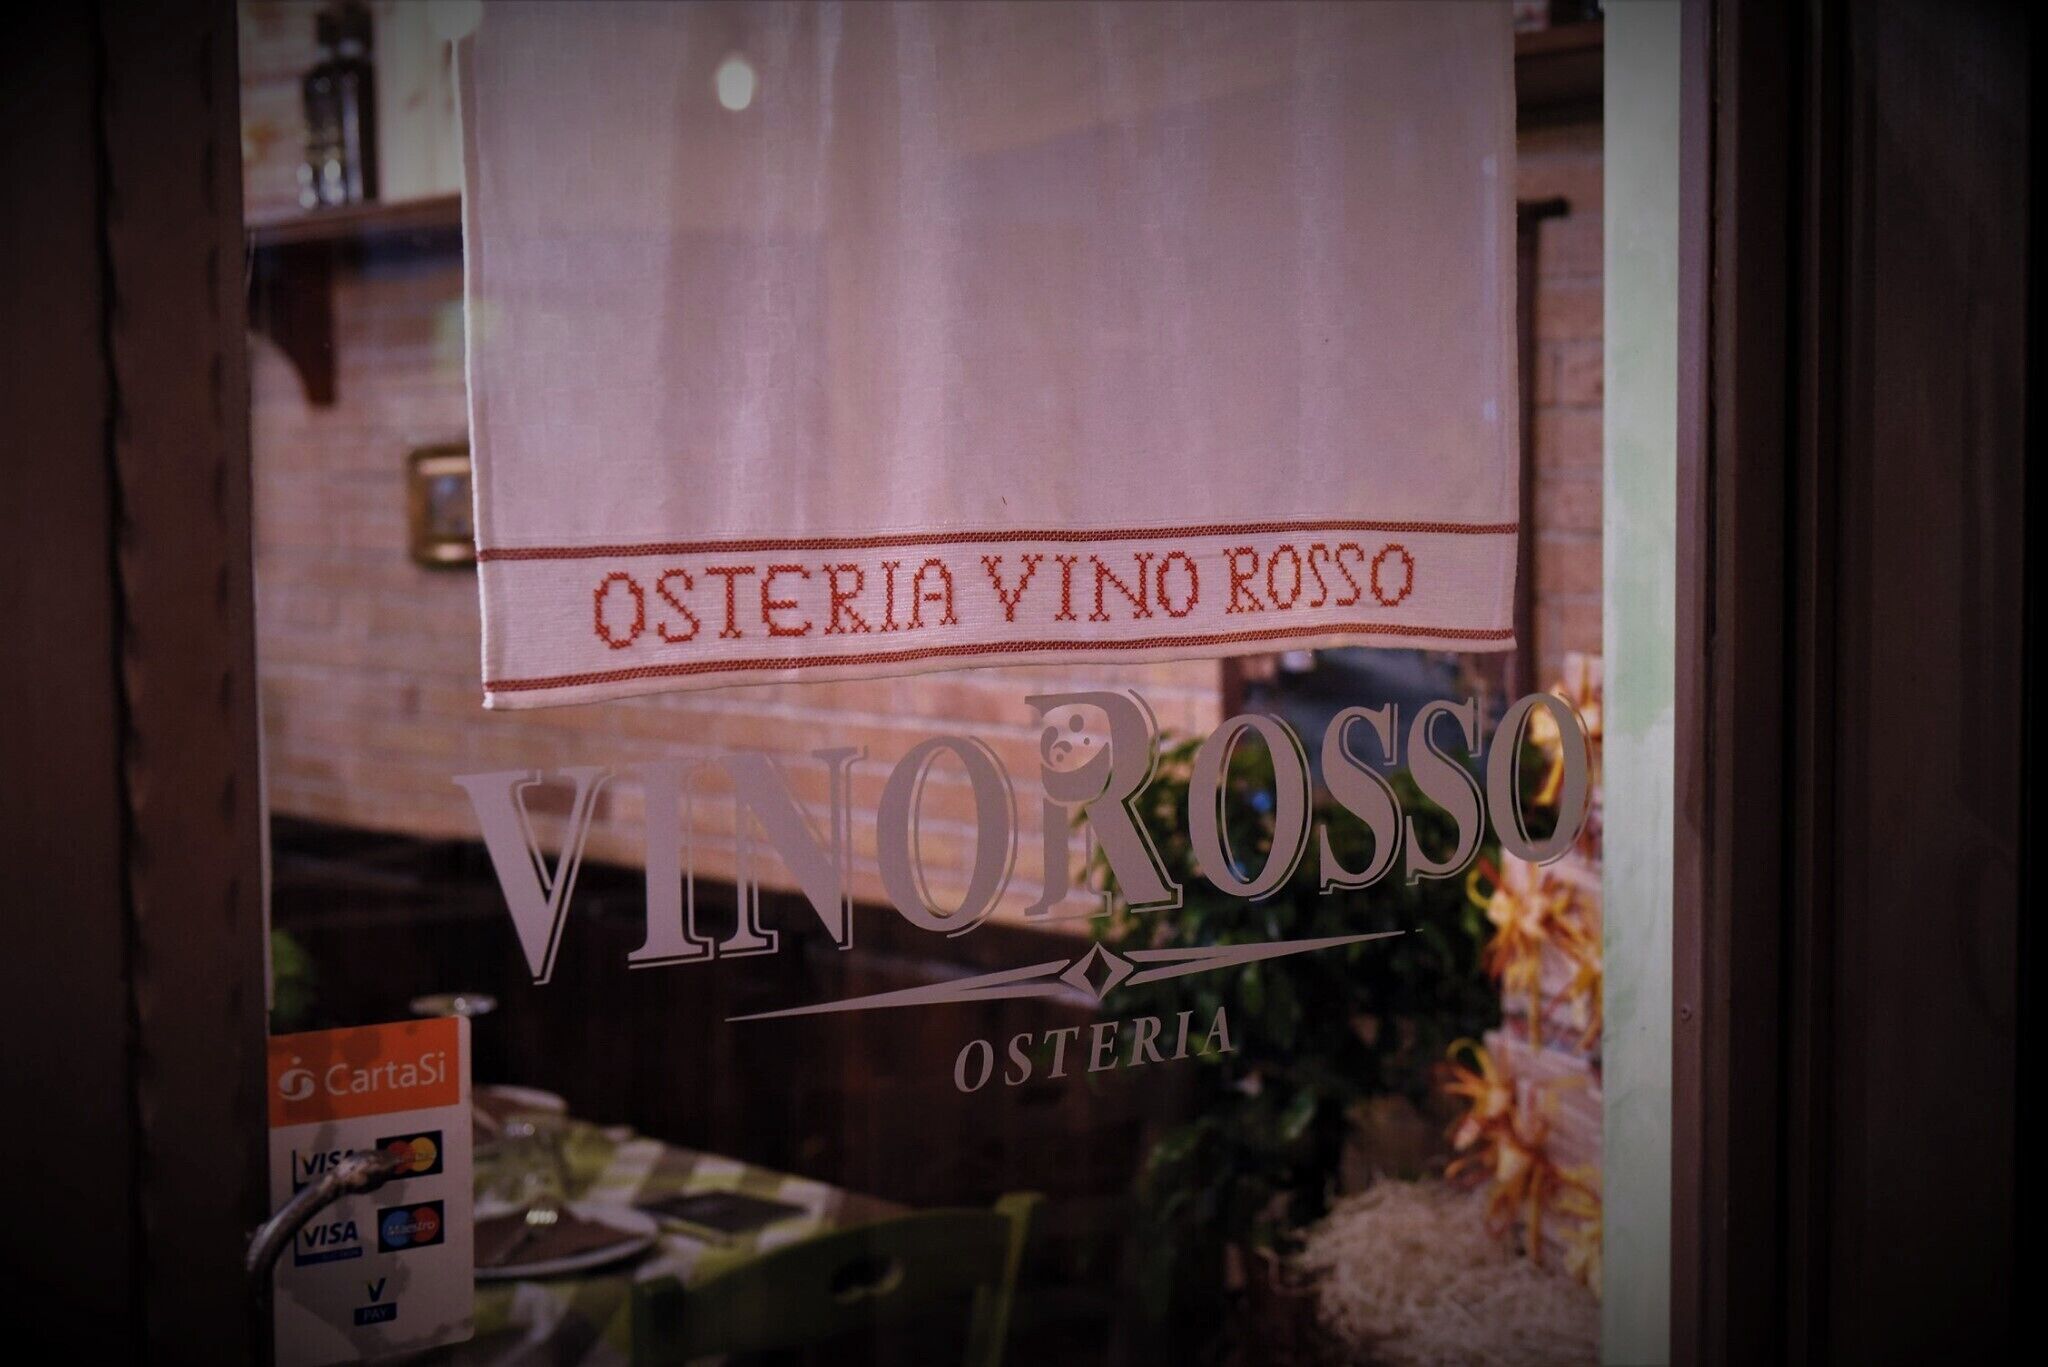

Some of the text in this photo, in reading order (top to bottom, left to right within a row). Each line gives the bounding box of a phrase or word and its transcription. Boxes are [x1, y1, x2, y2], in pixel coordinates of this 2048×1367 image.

[594, 542, 1415, 650] OSTERIA VINO ROSSO
[953, 1005, 1238, 1094] OSTERIA
[324, 1051, 446, 1096] CartaSi
[301, 1150, 354, 1176] VIS
[303, 1220, 358, 1248] VISA
